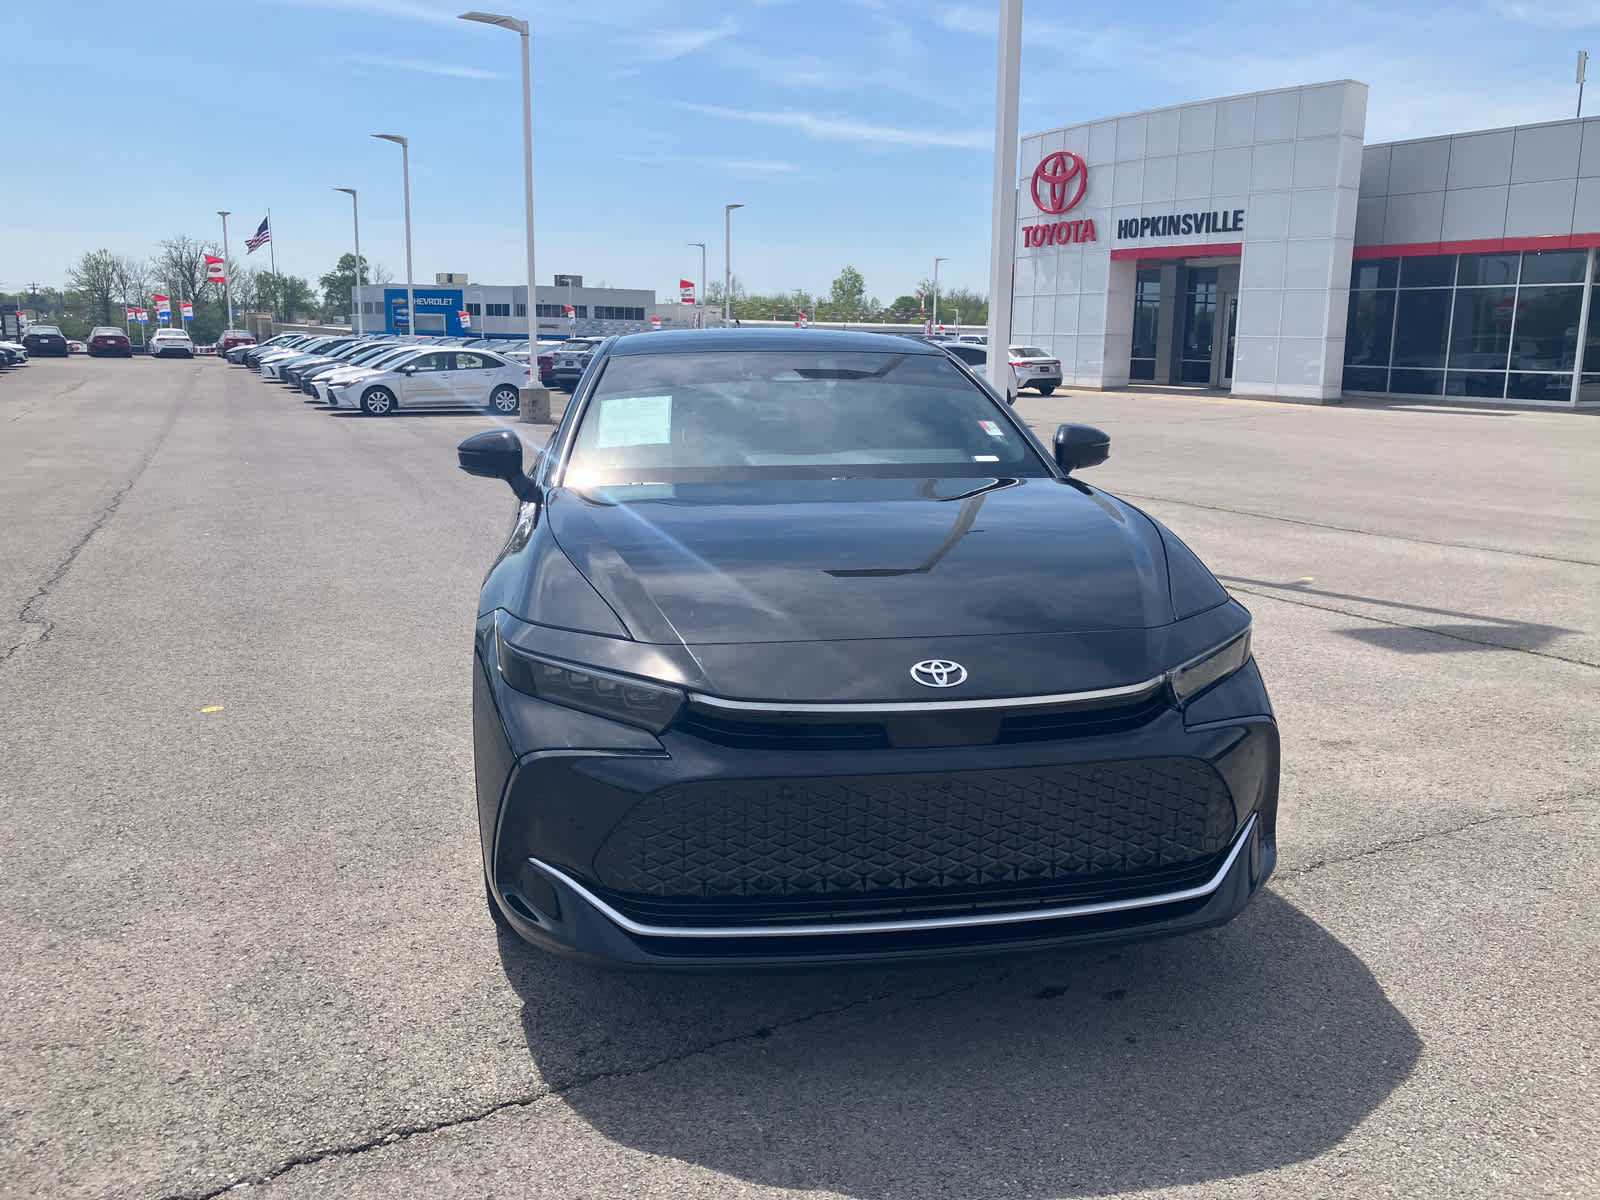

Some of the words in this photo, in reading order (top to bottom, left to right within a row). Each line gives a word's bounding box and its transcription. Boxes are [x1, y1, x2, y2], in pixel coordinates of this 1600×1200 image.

[1022, 218, 1096, 248] TOYOTA
[1117, 209, 1245, 239] HOPKINSVILLE
[412, 297, 453, 306] HEVROLET
